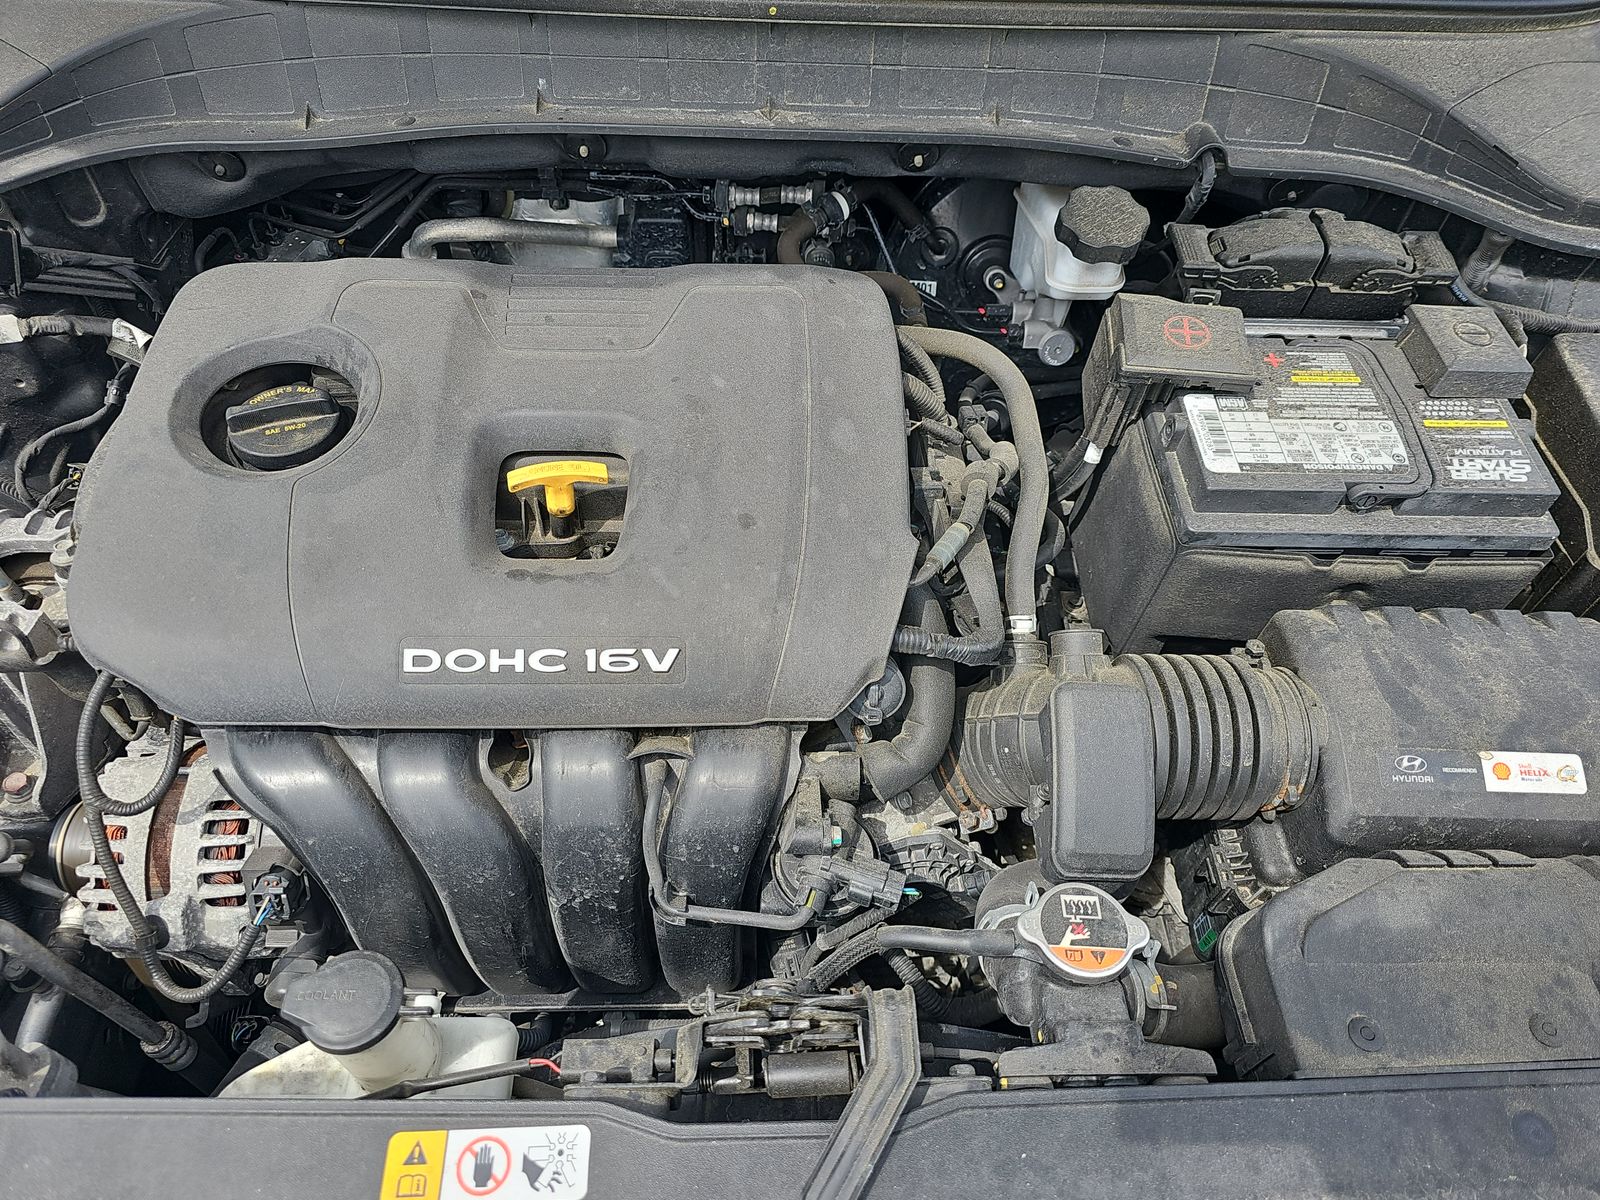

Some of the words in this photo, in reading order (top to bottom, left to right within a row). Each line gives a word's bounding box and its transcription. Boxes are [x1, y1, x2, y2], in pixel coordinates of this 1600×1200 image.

[249, 386, 293, 405] OWNER'S
[264, 428, 281, 436] SAE
[284, 422, 307, 432] 5W-20
[1303, 463, 1384, 471] DANGER/POISON
[1446, 459, 1531, 473] START
[1451, 469, 1528, 482] SUPER
[403, 648, 568, 674] DOHC
[585, 648, 681, 674] 16V
[1392, 774, 1434, 783] HYUNDAI
[1519, 769, 1550, 777] HELIX
[296, 989, 357, 1001] COOLANT
